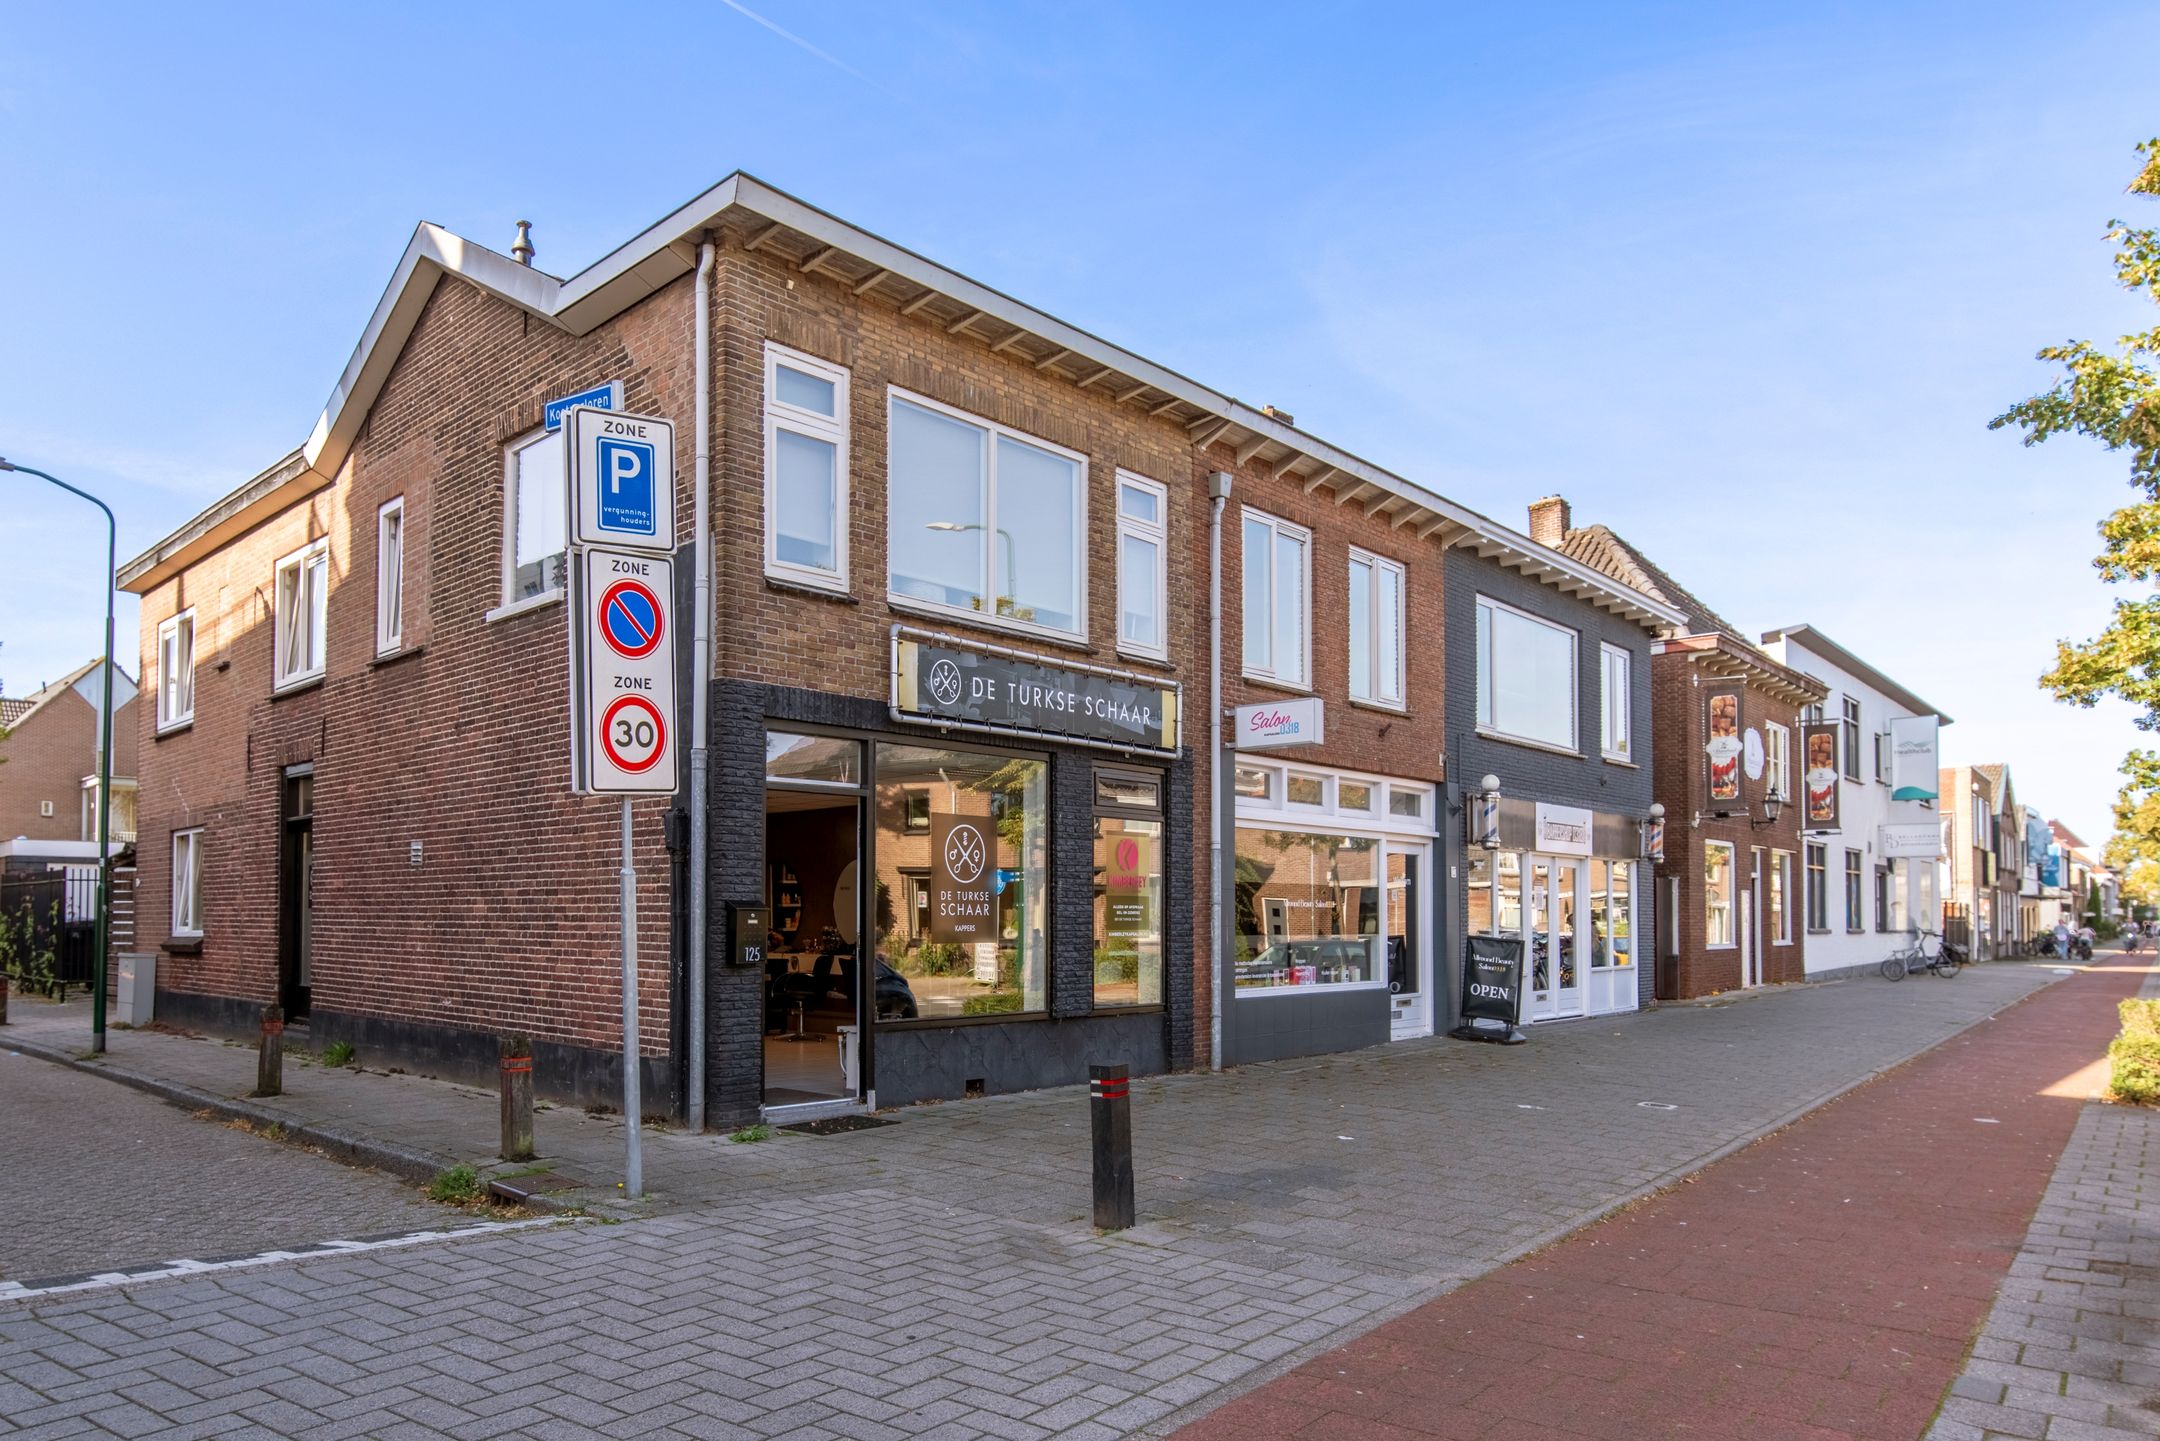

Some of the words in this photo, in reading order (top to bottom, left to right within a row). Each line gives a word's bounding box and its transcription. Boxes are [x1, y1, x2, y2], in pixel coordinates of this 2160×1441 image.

[549, 395, 609, 422] Koloren
[604, 420, 647, 438] ZONE
[611, 448, 641, 494] P
[603, 506, 650, 518] vergunning-
[620, 517, 650, 526] houders
[612, 560, 650, 576] ZONE
[614, 676, 652, 690] ZONE
[972, 676, 996, 700] DE
[1008, 683, 1075, 713] TURKSE
[1085, 696, 1151, 725] SCHAAR
[1250, 711, 1291, 731] Salon
[1280, 722, 1300, 735] 0318
[615, 720, 654, 748] 30
[940, 890, 952, 901] DE
[956, 891, 990, 901] TURKSE
[940, 903, 990, 916] SCHAAR
[954, 924, 976, 932] KAPPERS
[744, 946, 761, 962] 125
[1470, 983, 1510, 1000] OPEN
